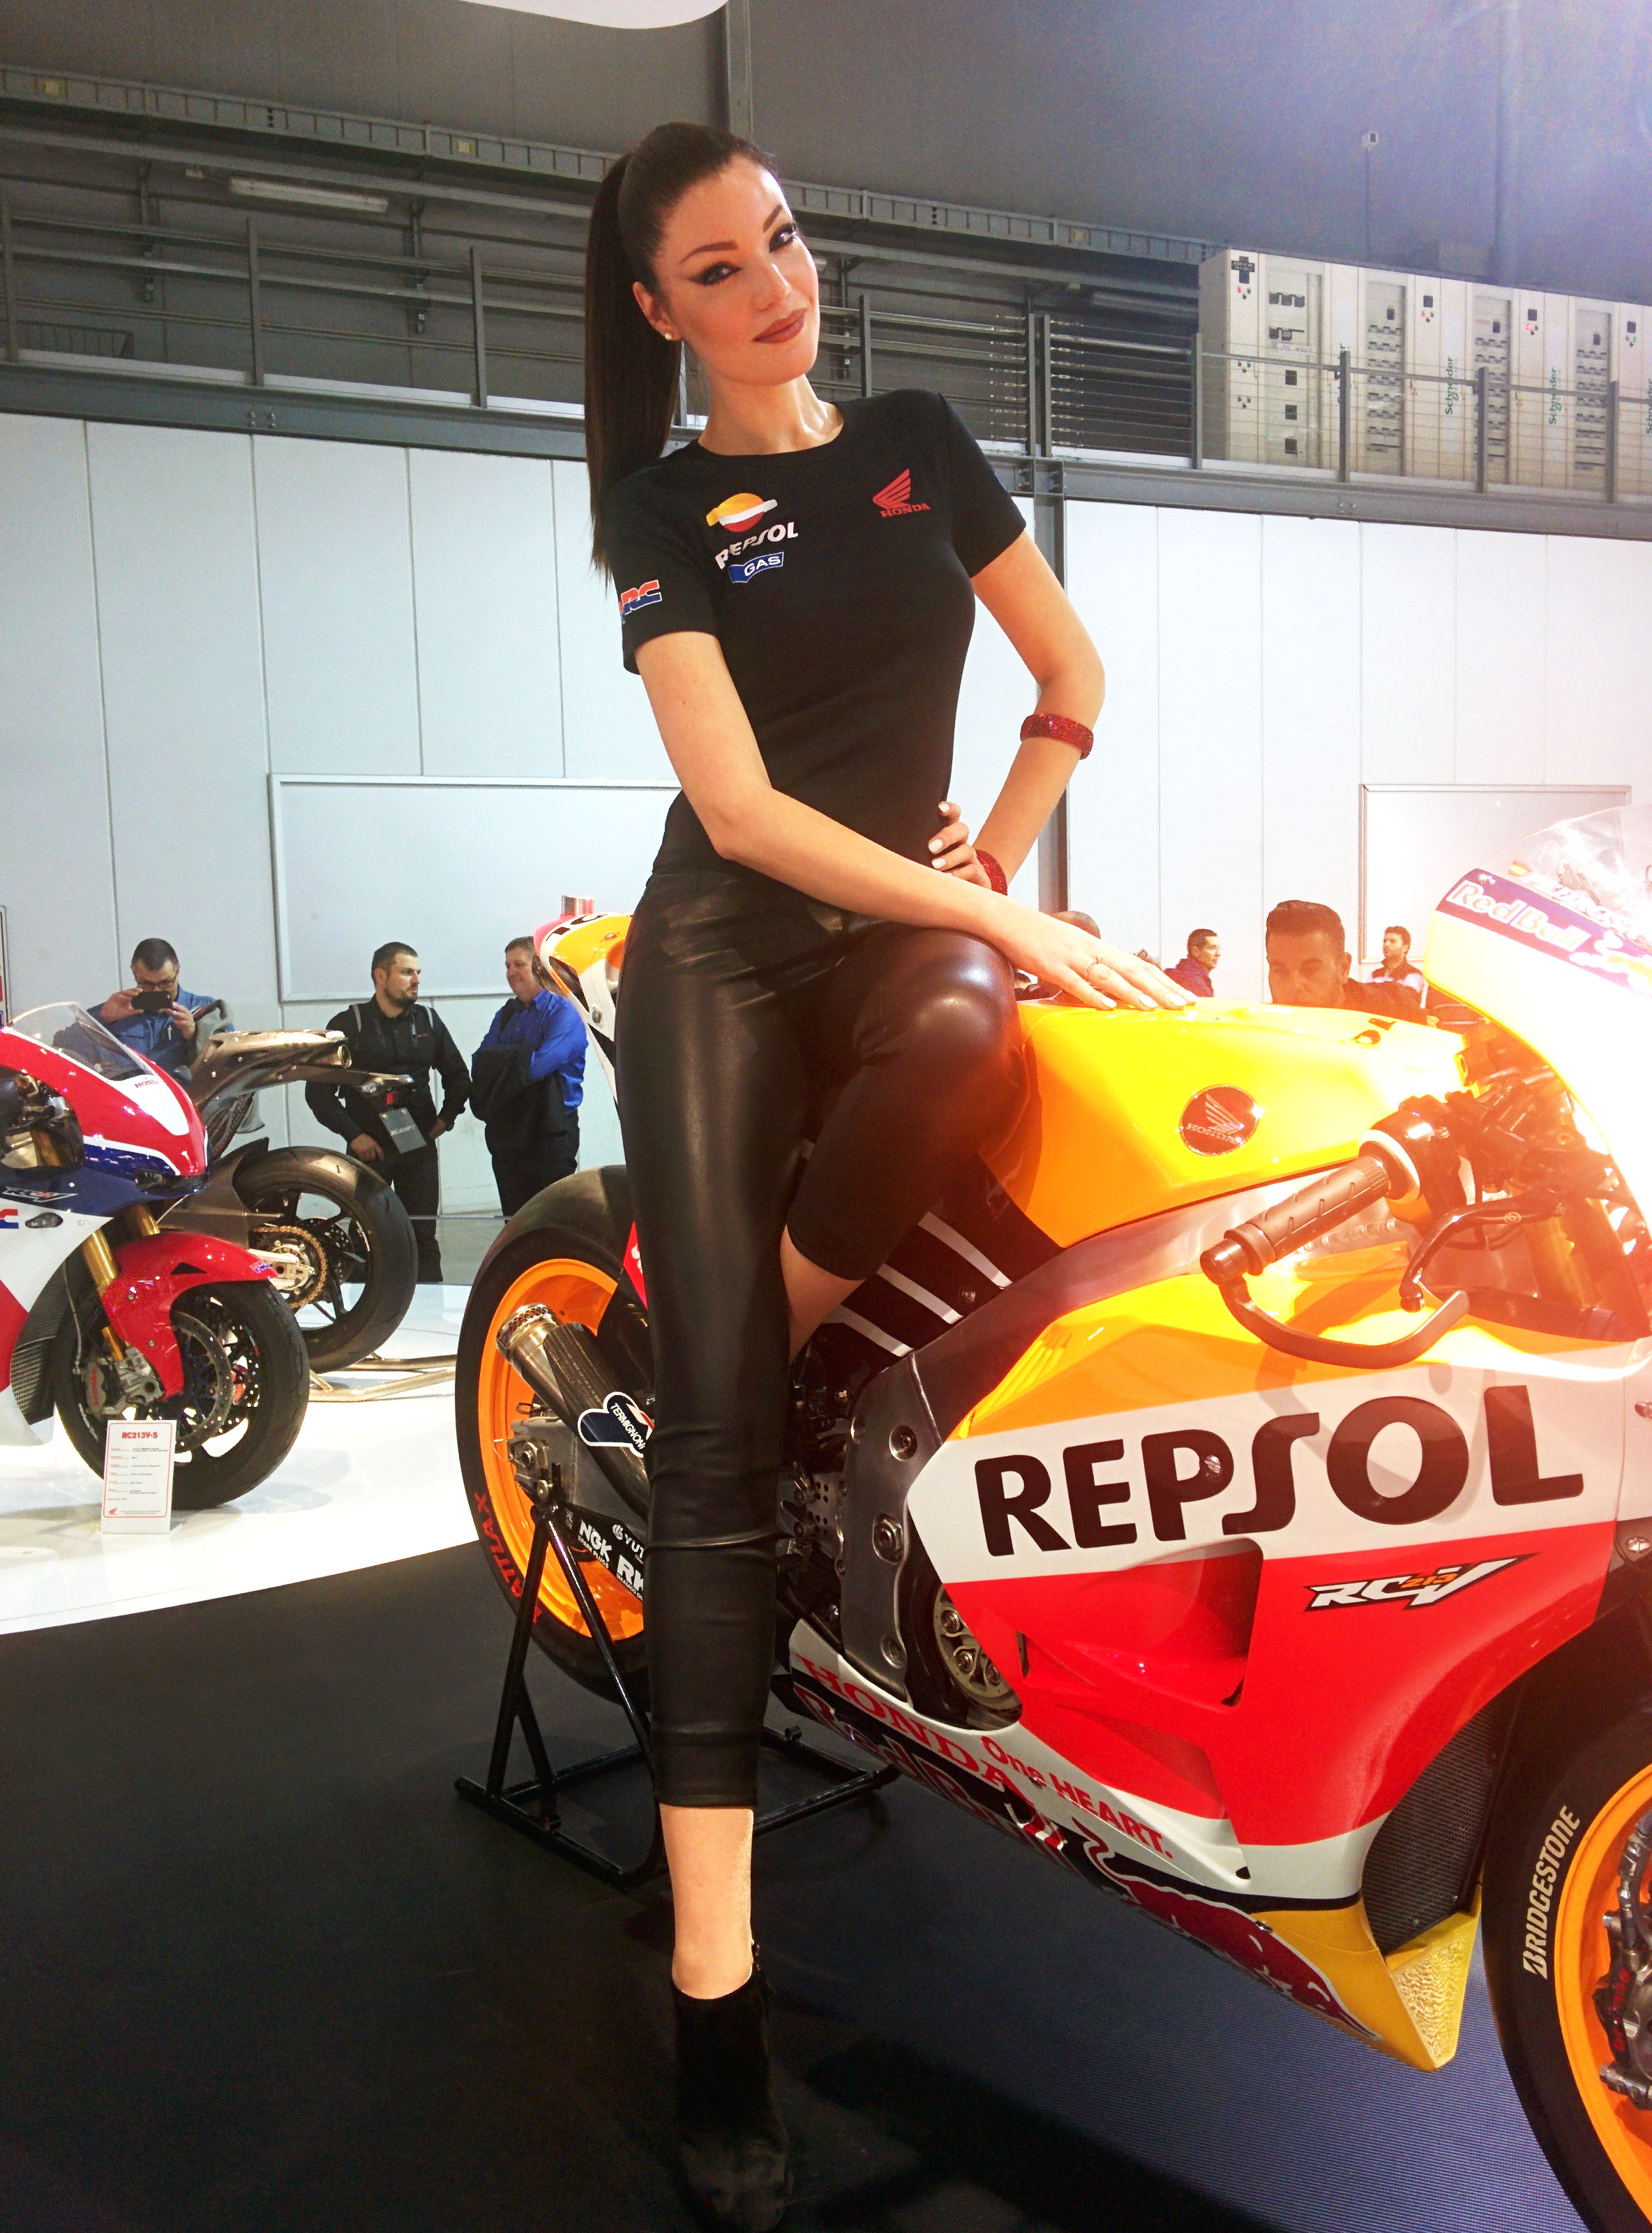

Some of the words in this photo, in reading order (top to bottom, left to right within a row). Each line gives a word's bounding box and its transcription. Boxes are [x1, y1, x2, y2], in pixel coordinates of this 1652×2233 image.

[1445, 357, 1456, 415] Schneder
[1549, 367, 1560, 424] Schneder
[880, 502, 931, 517] HONDA
[714, 521, 798, 569] REPSOL
[744, 556, 781, 576] GAS
[1446, 880, 1528, 924] Red
[1509, 905, 1591, 952] Bull
[1185, 1123, 1238, 1145] HONDA
[975, 1384, 1584, 1557] REPSOL
[474, 1491, 543, 1624] ATTLAX
[579, 1518, 613, 1562] NGK
[795, 1654, 1035, 1807] HONDA
[981, 1735, 1046, 1788] One
[1049, 1772, 1174, 1860] HEART.
[1523, 1805, 1581, 1980] BRIDGESTONE
